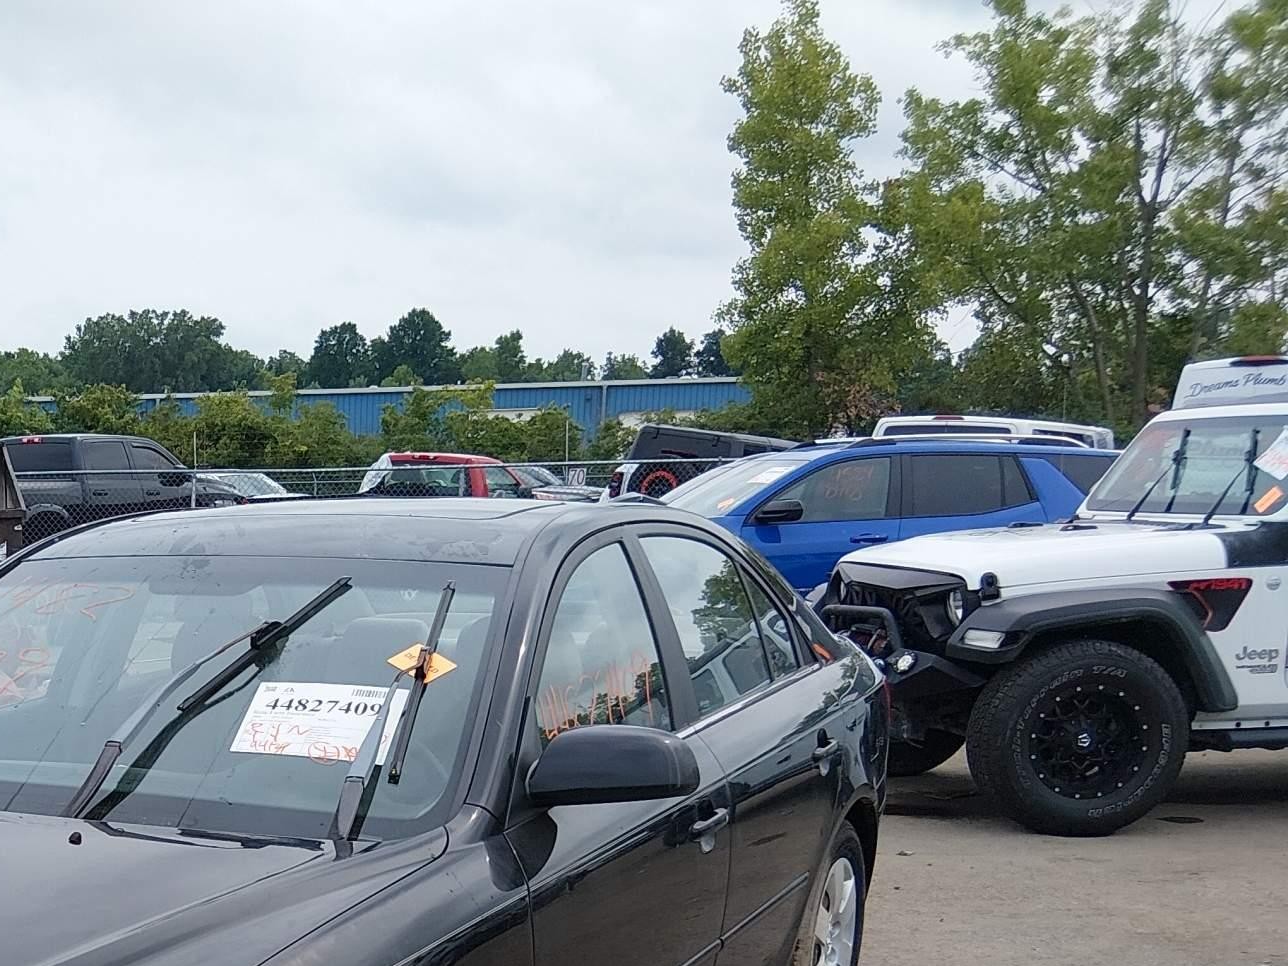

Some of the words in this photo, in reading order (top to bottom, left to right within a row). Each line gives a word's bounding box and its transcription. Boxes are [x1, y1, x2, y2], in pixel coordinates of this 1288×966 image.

[569, 469, 585, 486] 70
[1235, 646, 1279, 662] Jeep
[265, 697, 384, 717] 44827409
